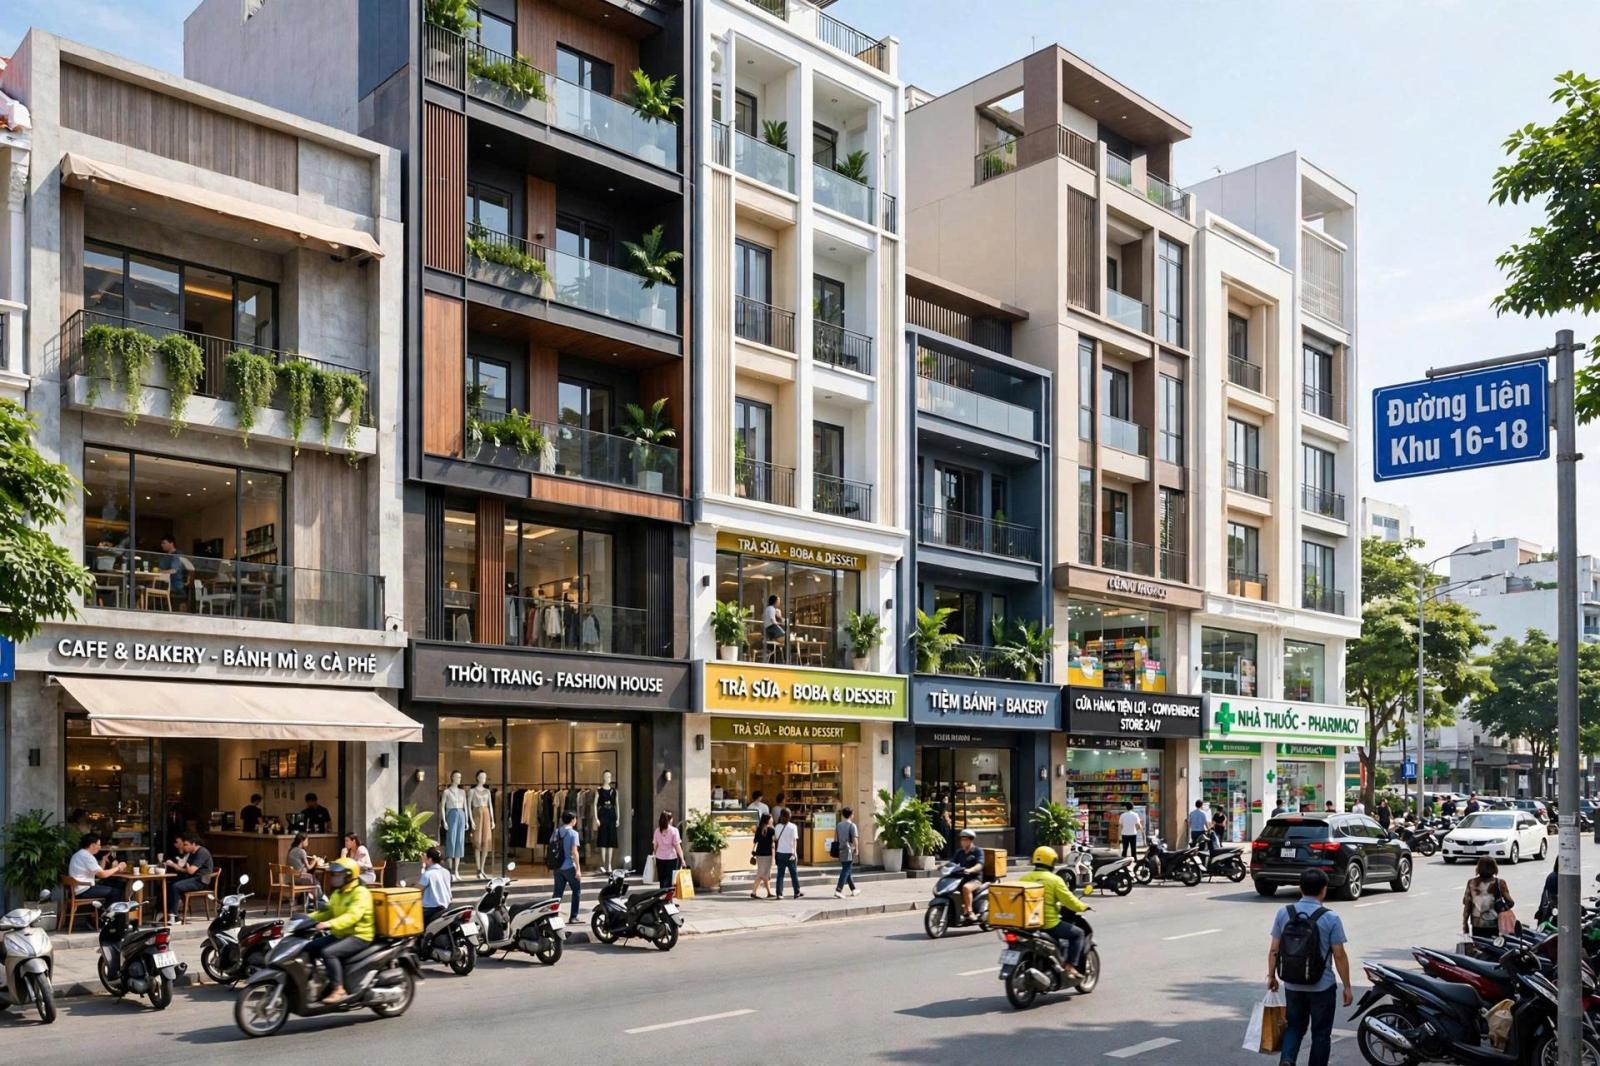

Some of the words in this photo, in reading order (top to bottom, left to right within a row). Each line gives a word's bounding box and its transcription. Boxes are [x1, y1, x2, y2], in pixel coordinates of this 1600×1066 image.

[1388, 392, 1466, 426] Đường
[1476, 380, 1530, 413] Liên
[1391, 436, 1440, 466] Khu
[1450, 418, 1528, 456] 16-18
[738, 538, 758, 552] TRÀ
[790, 547, 814, 560] BOBA
[816, 552, 822, 561] &
[58, 639, 108, 660] CAFE
[115, 643, 128, 660] &
[135, 644, 206, 664] BAKERY
[224, 645, 272, 668] BÁNH
[278, 649, 298, 670] MÌ
[304, 654, 316, 671] &
[320, 650, 342, 672] CÀ
[448, 662, 487, 683] THỜI
[492, 668, 542, 686] TRANG
[557, 672, 616, 690] FASHION
[621, 676, 662, 692] HOUSE
[720, 676, 748, 696] TRÀ
[793, 684, 828, 702] BOBA
[832, 688, 842, 702] &
[846, 688, 896, 705] DESSERT
[930, 688, 960, 712] TIỆM
[963, 690, 996, 712] BÁNH
[1006, 697, 1048, 714] BAKERY
[1093, 696, 1116, 712] HÀNG
[733, 722, 751, 735] TRÀ
[778, 726, 802, 736] BOBA
[803, 728, 810, 737] &
[812, 727, 844, 738] DESSERT
[1120, 718, 1144, 730] STORE
[1145, 720, 1161, 732] 24/7
[1238, 706, 1260, 728] NHÀ
[1264, 708, 1298, 730] THUỐC
[1308, 716, 1360, 734] PHARMACY
